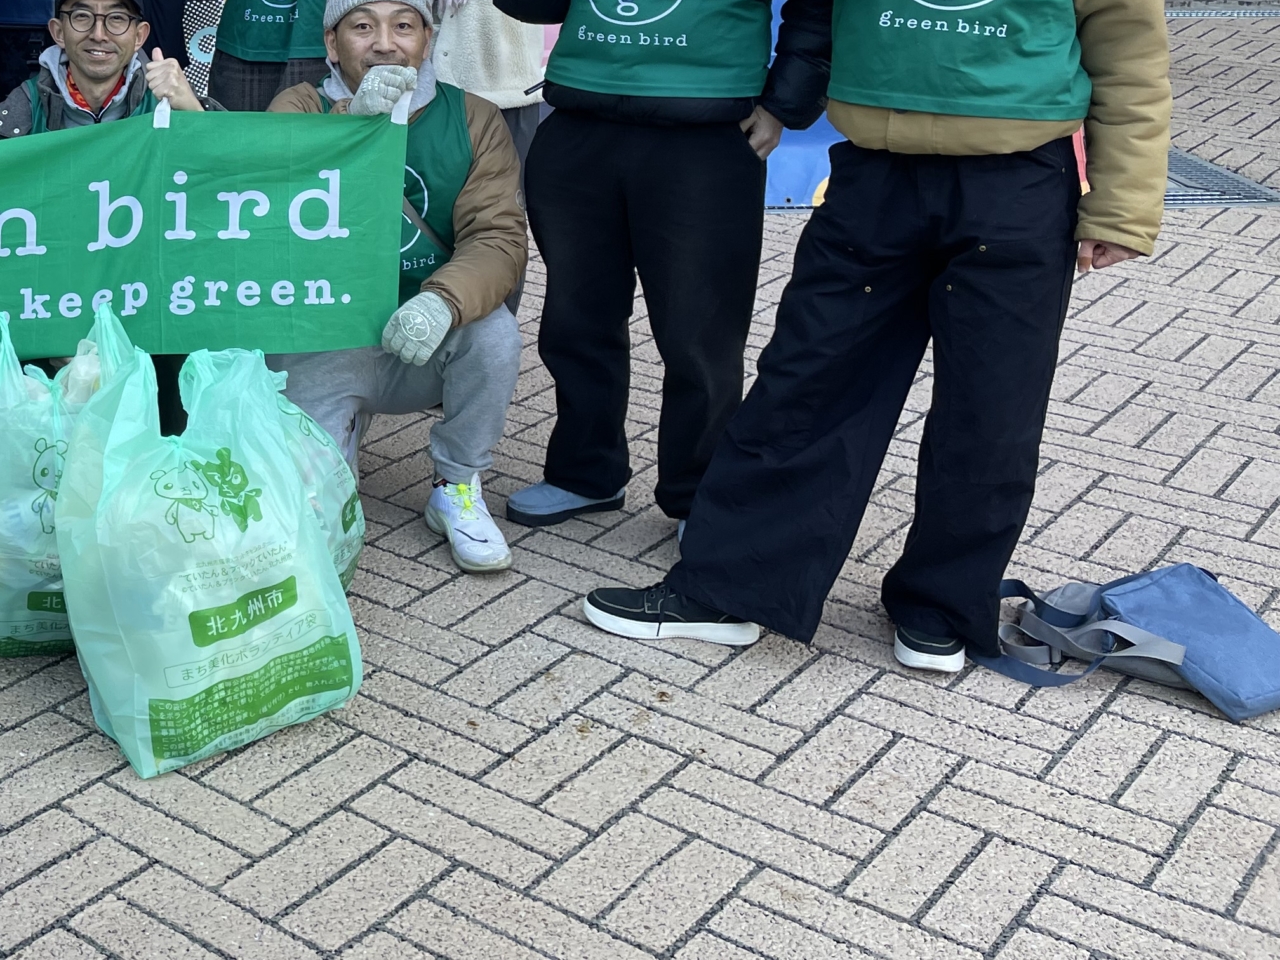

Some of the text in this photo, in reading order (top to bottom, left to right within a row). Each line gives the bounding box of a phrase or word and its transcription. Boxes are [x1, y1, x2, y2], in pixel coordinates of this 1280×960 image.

[244, 8, 285, 23] green
[879, 10, 1008, 38] green bird
[578, 25, 688, 47] green bird
[87, 169, 350, 252] bird
[402, 253, 436, 271] bird
[19, 281, 148, 319] keep
[169, 276, 352, 316] green.
[206, 589, 284, 636] 北九州市
[180, 612, 318, 682] まち美化ボランティア袋
